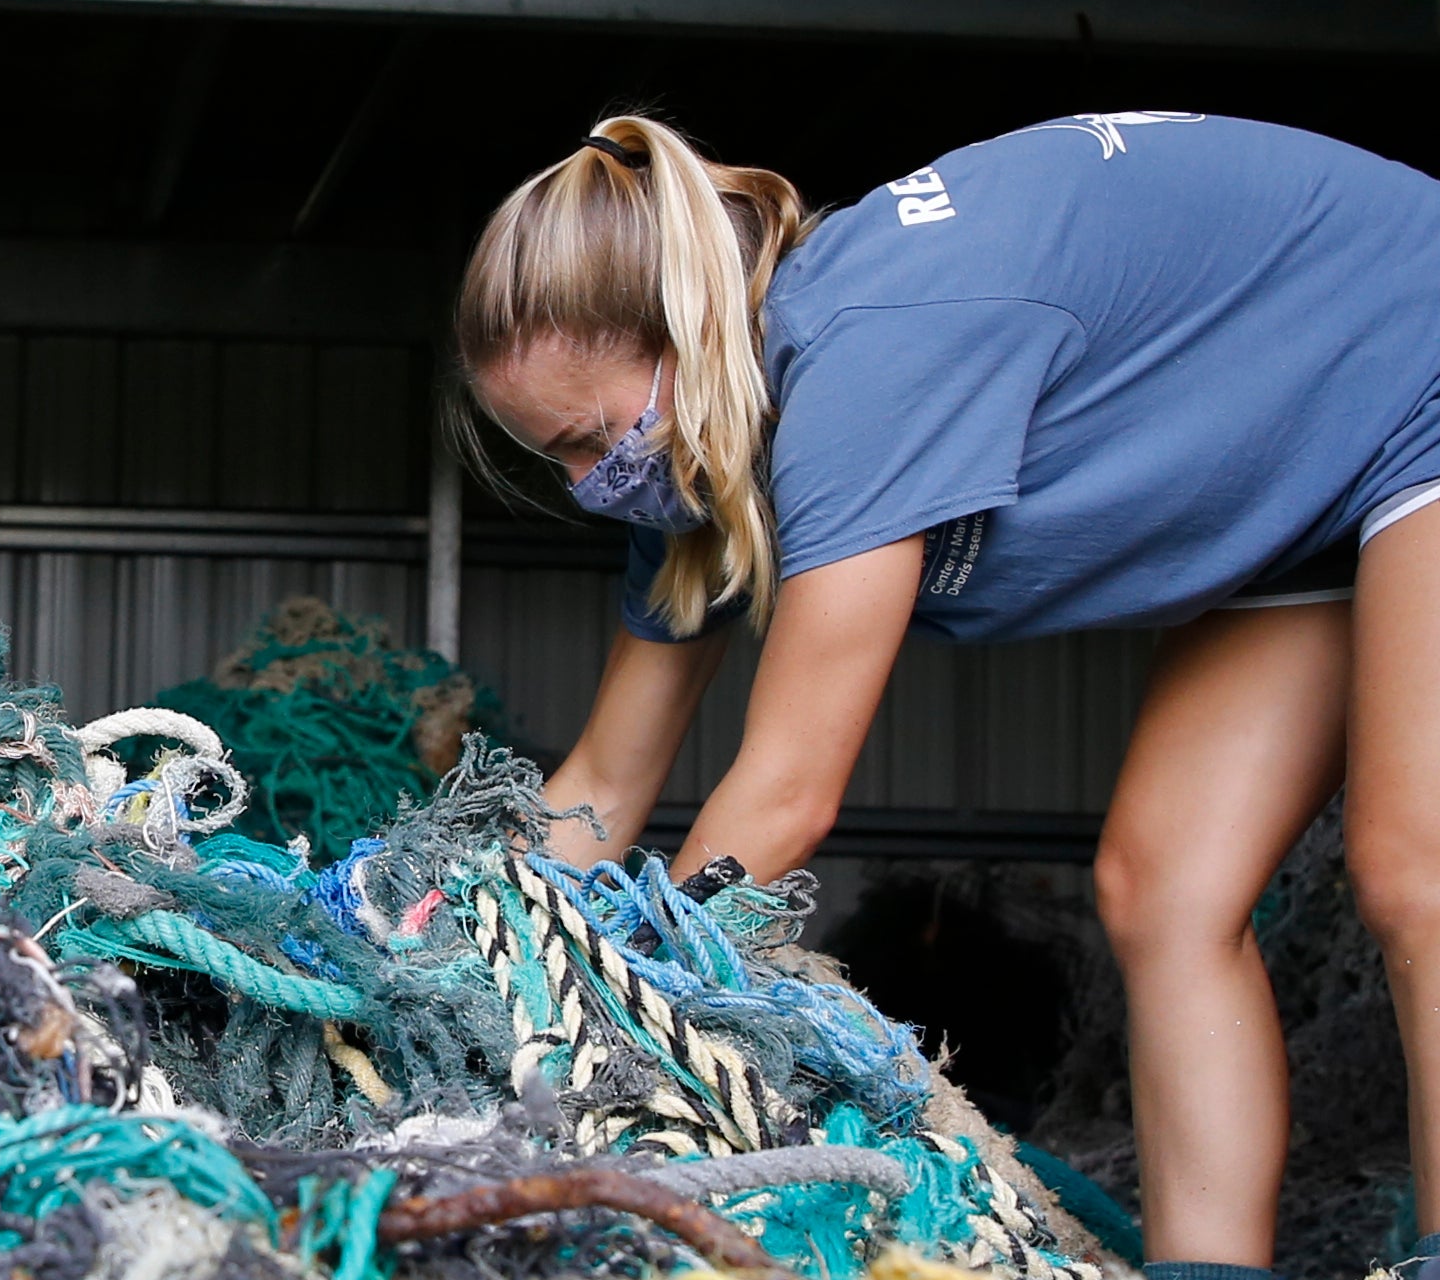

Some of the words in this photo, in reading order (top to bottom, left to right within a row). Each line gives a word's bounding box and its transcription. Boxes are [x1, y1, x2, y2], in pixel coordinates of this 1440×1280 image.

[886, 166, 956, 226] RE
[930, 557, 956, 594] Center
[946, 562, 973, 597] Debris
